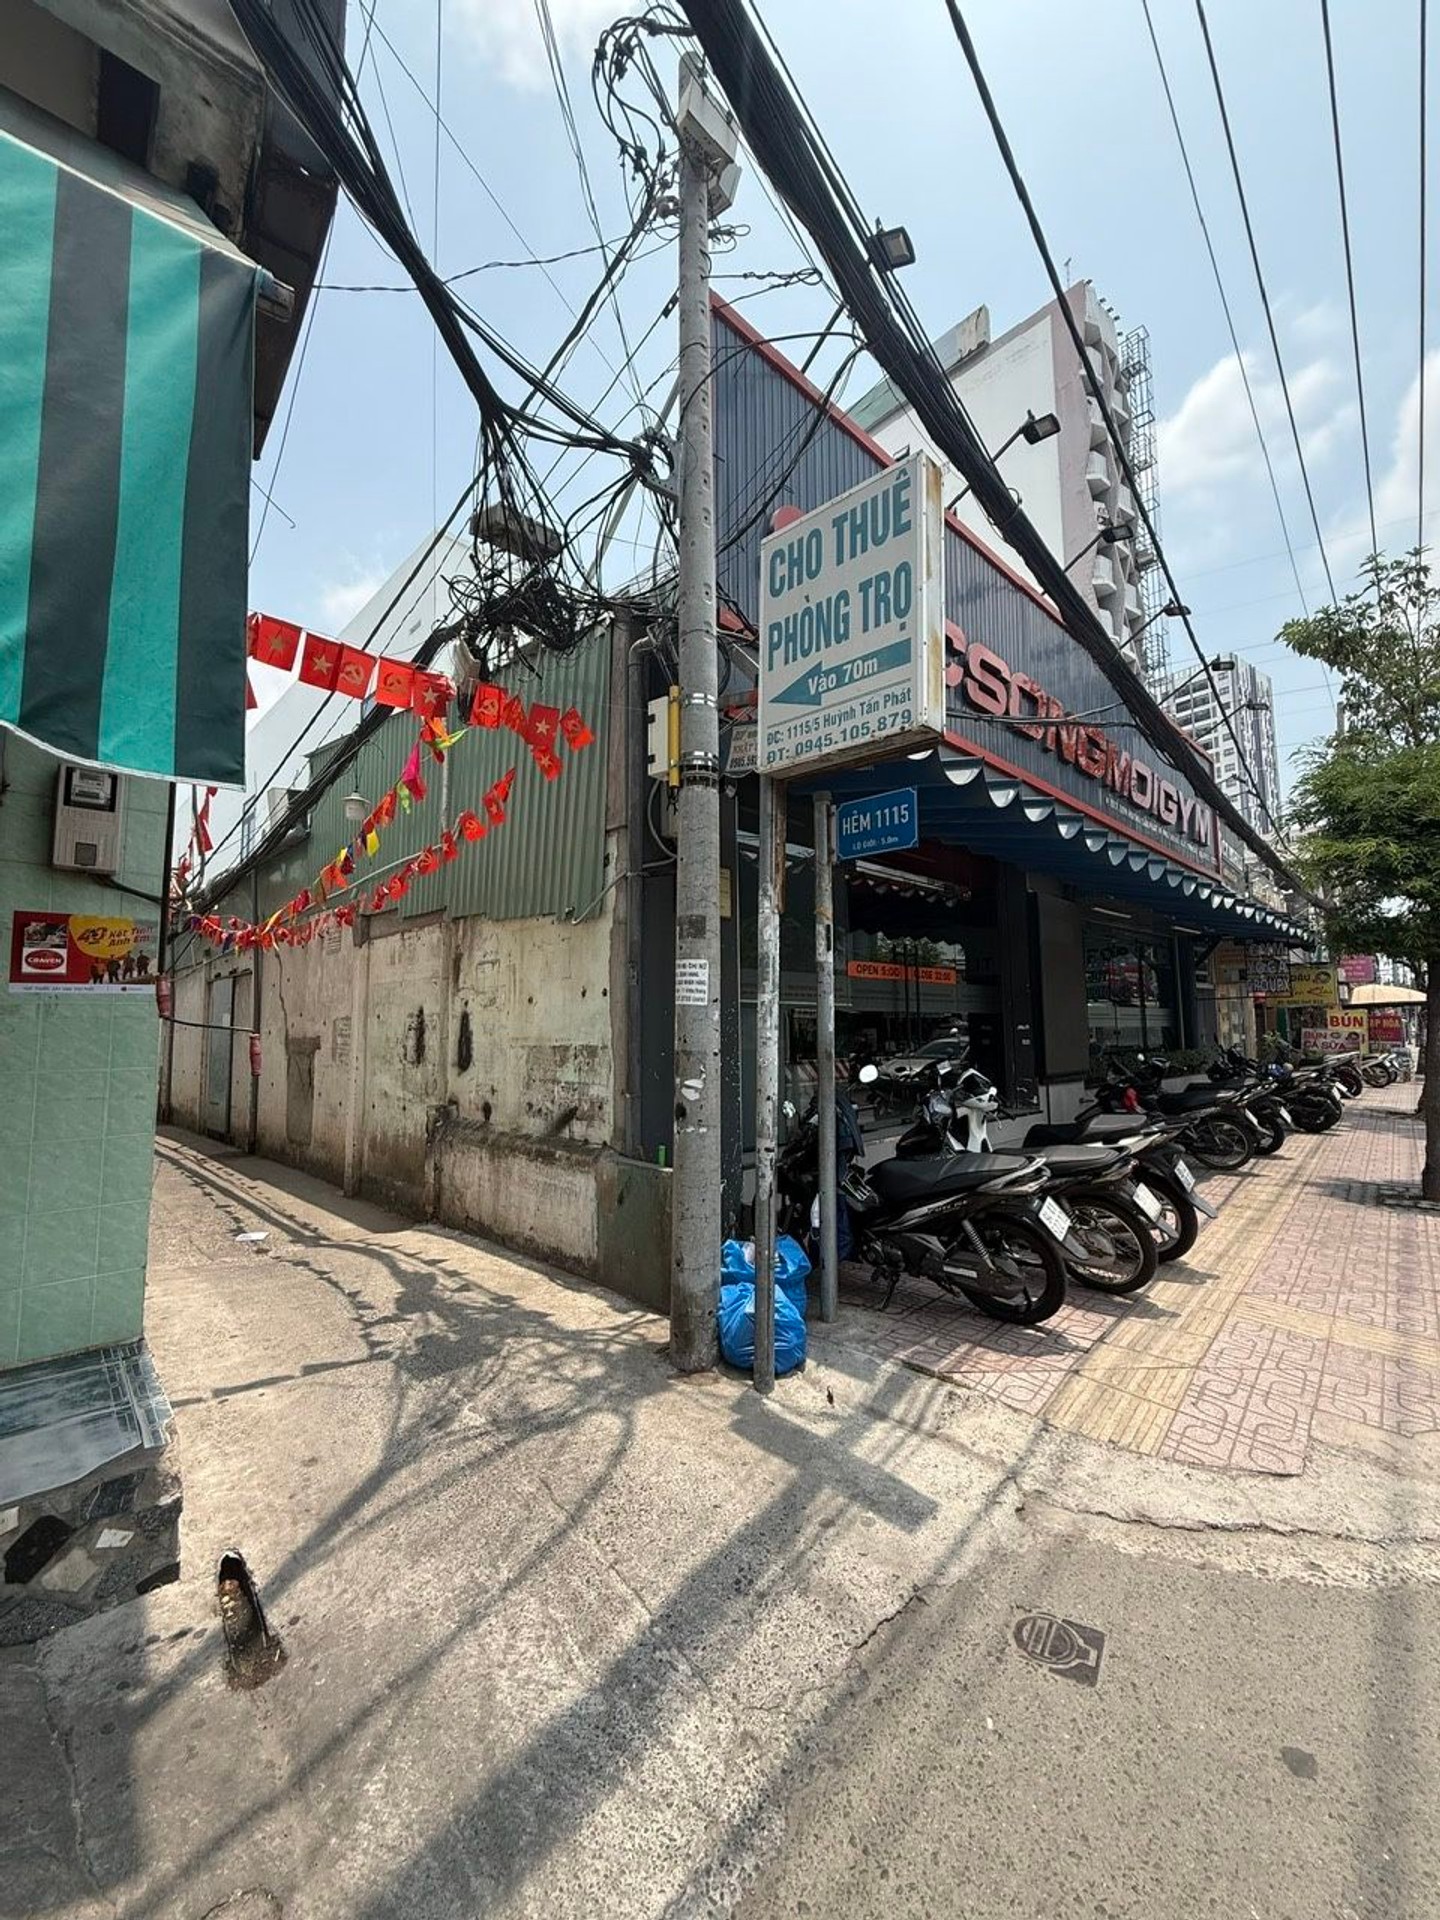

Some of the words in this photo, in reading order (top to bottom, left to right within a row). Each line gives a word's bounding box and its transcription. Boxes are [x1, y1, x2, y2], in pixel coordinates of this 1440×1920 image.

[769, 527, 822, 598] CHO
[832, 468, 911, 567] THUÊ
[768, 588, 850, 672] PHÒNG
[858, 561, 911, 632] TRỌ
[808, 673, 836, 695] Vào
[842, 657, 877, 683] 70m
[767, 730, 784, 746] ĐC:
[788, 717, 820, 740] 1115/5
[823, 705, 856, 728] Huỳnh
[884, 687, 911, 709] Phát
[767, 747, 790, 765] ĐT:
[795, 708, 912, 756] 0945.105.879
[842, 810, 871, 836] HẺM
[875, 803, 909, 828] 1115
[856, 964, 879, 975] OPEN
[1330, 1012, 1364, 1028] BÚN
